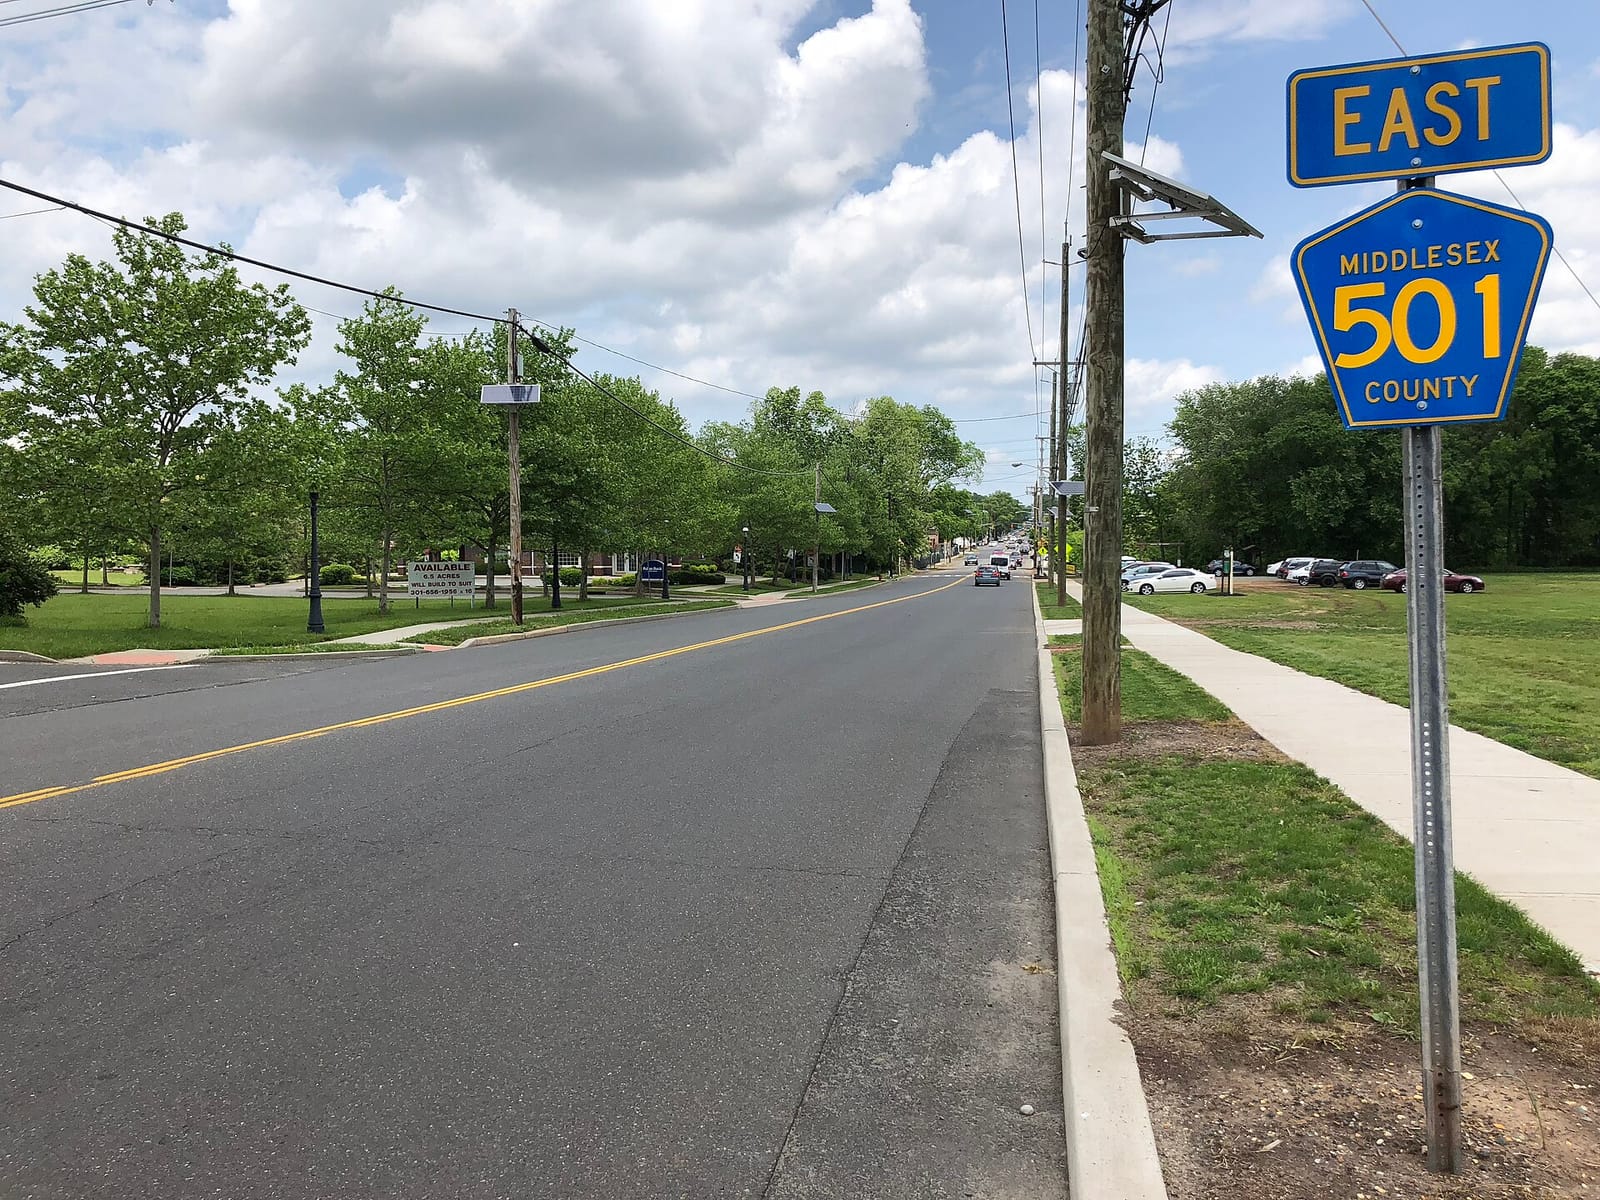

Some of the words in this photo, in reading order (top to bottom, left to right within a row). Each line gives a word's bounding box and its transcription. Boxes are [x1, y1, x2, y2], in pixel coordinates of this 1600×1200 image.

[1334, 76, 1501, 157] EAST
[1340, 239, 1501, 275] MIDDLESEX
[1334, 273, 1501, 369] 501
[1365, 375, 1479, 404] COUNTY
